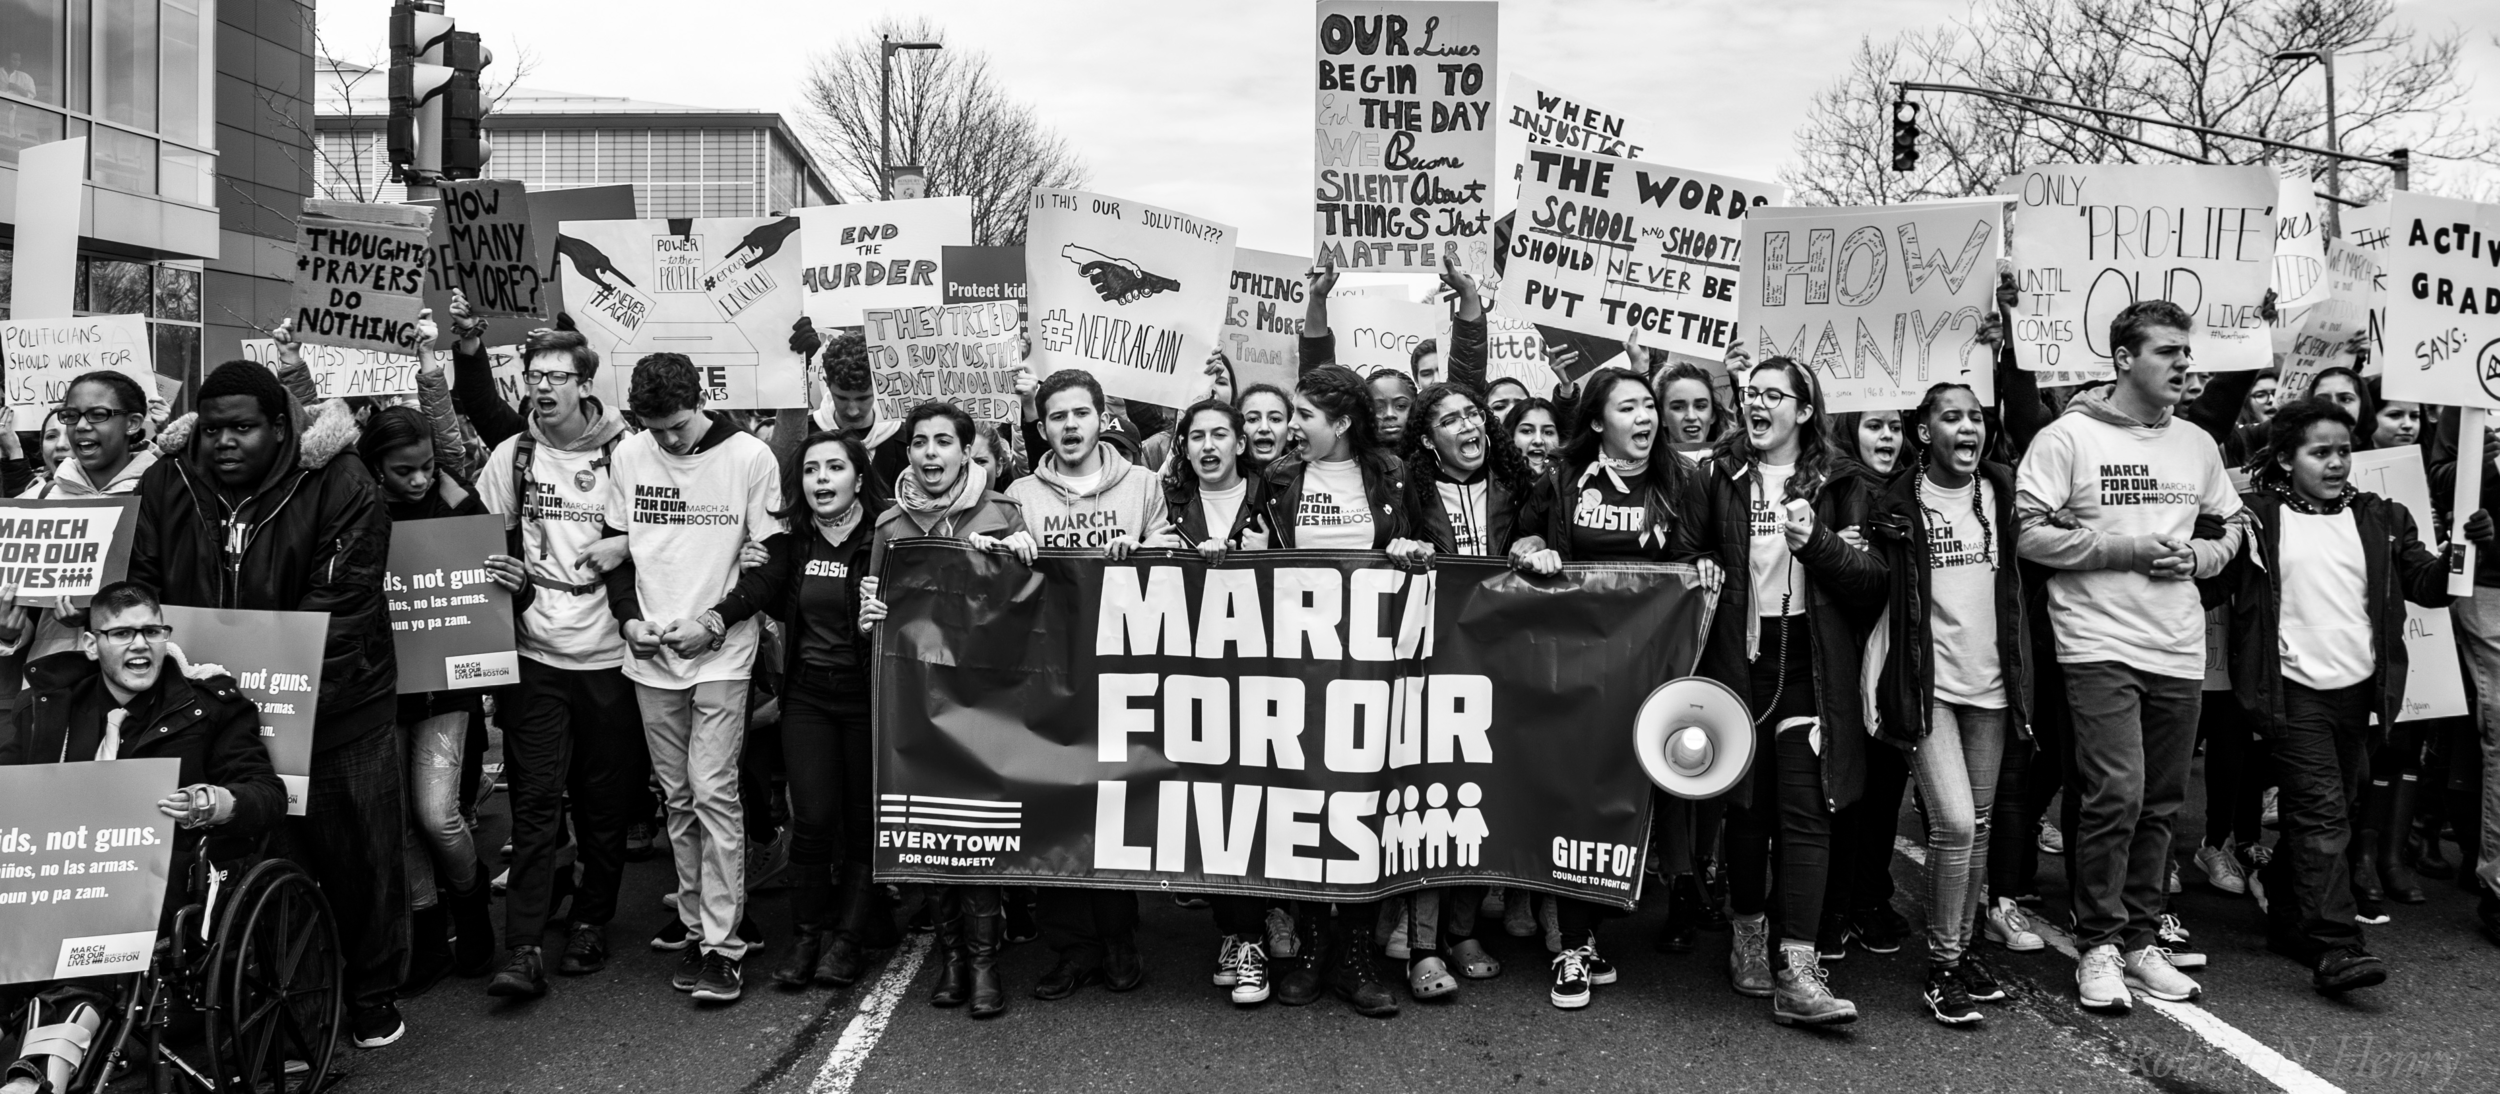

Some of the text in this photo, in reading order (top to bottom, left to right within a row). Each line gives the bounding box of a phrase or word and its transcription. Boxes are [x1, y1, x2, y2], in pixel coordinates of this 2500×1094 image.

[1320, 13, 1481, 57] OUR Lives
[1319, 59, 1484, 96] BEGIN TO
[1318, 93, 1491, 133] End THE DAY
[1537, 89, 1625, 138] WHEN
[1509, 104, 1644, 160] INJUSTICE
[1316, 128, 1465, 171] WE Become
[1316, 169, 1409, 204] SILENT
[1410, 171, 1486, 206] About
[1530, 149, 1615, 199] THE
[2023, 172, 2087, 207] ONLY
[442, 187, 500, 225] HOW
[1034, 193, 1224, 245] IS THIS OUR SOLUTION???
[840, 223, 899, 246] END
[1316, 203, 1491, 240] THINGS That
[1531, 195, 1741, 263] SCHOOL AND SHOOTI
[449, 223, 526, 264] MANY
[657, 238, 699, 253] POWER
[855, 244, 883, 256] THE
[1316, 240, 1462, 269] MATTER
[802, 259, 938, 293] MURDER
[1511, 233, 1737, 303] SHOULD NEVER BE
[1762, 218, 1993, 307] HOW
[456, 260, 541, 314] MORE?
[659, 266, 700, 291] PEOPLE
[948, 281, 1028, 299] Protect kid
[1230, 269, 1304, 304] OTHING
[2017, 267, 2071, 293] UNTIL
[328, 288, 362, 310] DO
[718, 270, 776, 317] ENOUGH
[2031, 293, 2056, 318] IT
[602, 301, 641, 332] AGAIN
[867, 305, 946, 341] THEY
[946, 302, 1019, 338] TRIED
[1256, 300, 1305, 336] MORE
[1524, 279, 1585, 319] PUT
[1600, 297, 1738, 349] TOGETHE
[2206, 302, 2263, 330] LIVES
[6, 324, 102, 349] POLITICIANS
[296, 307, 417, 349] NOTHING
[2016, 319, 2074, 343] COMES
[9, 349, 132, 371] SHOULD WORK FOR
[868, 344, 899, 369] TO
[906, 341, 960, 369] BURY
[1229, 333, 1283, 366] THAN
[1758, 305, 1985, 388] MANY?
[2034, 343, 2061, 366] TO
[2415, 327, 2468, 371] SAYS:
[346, 363, 421, 394] AMERIC
[938, 368, 992, 395] KNOW
[992, 370, 1020, 395] WE
[2100, 464, 2149, 477] MARCH
[635, 484, 680, 500] MARCH
[2101, 478, 2196, 492] FOR OUR MARCH 24
[563, 501, 594, 511] MARCH
[595, 503, 606, 512] 24
[634, 497, 730, 513] FOR OUR MARCH 24
[1311, 504, 1341, 515] OUR
[2101, 492, 2202, 506] LIVES BOSTON
[633, 511, 740, 526] LIVES BOSTON
[1044, 510, 1117, 532] MARCH
[43, 542, 99, 564] OUR
[1044, 533, 1083, 547] FOR
[412, 568, 445, 590] not
[413, 593, 489, 610] no las armas.
[1096, 565, 1437, 662] MARCH
[411, 619, 425, 632] yo
[427, 617, 442, 631] pa
[444, 614, 471, 626] zam.
[454, 661, 481, 670] MARCH
[482, 669, 509, 678] BOSTON
[239, 668, 312, 695] not guns.
[264, 702, 296, 715] armas.
[1098, 672, 1493, 774] FOR OUR
[45, 825, 161, 853] not guns.
[879, 830, 1021, 853] EVERYTOWN
[1094, 780, 1381, 885] LIVES
[40, 859, 139, 877] no las armas.
[898, 853, 996, 867] FOR GUN SAFETY
[1552, 870, 1620, 889] COURAGE TO FIGHT
[30, 886, 109, 905] yo pa zam.
[67, 959, 90, 967] LIVES
[103, 954, 139, 964] BOSTON
[69, 953, 86, 961] FOR
[87, 951, 105, 959] OUR
[70, 944, 106, 954] MARCH
